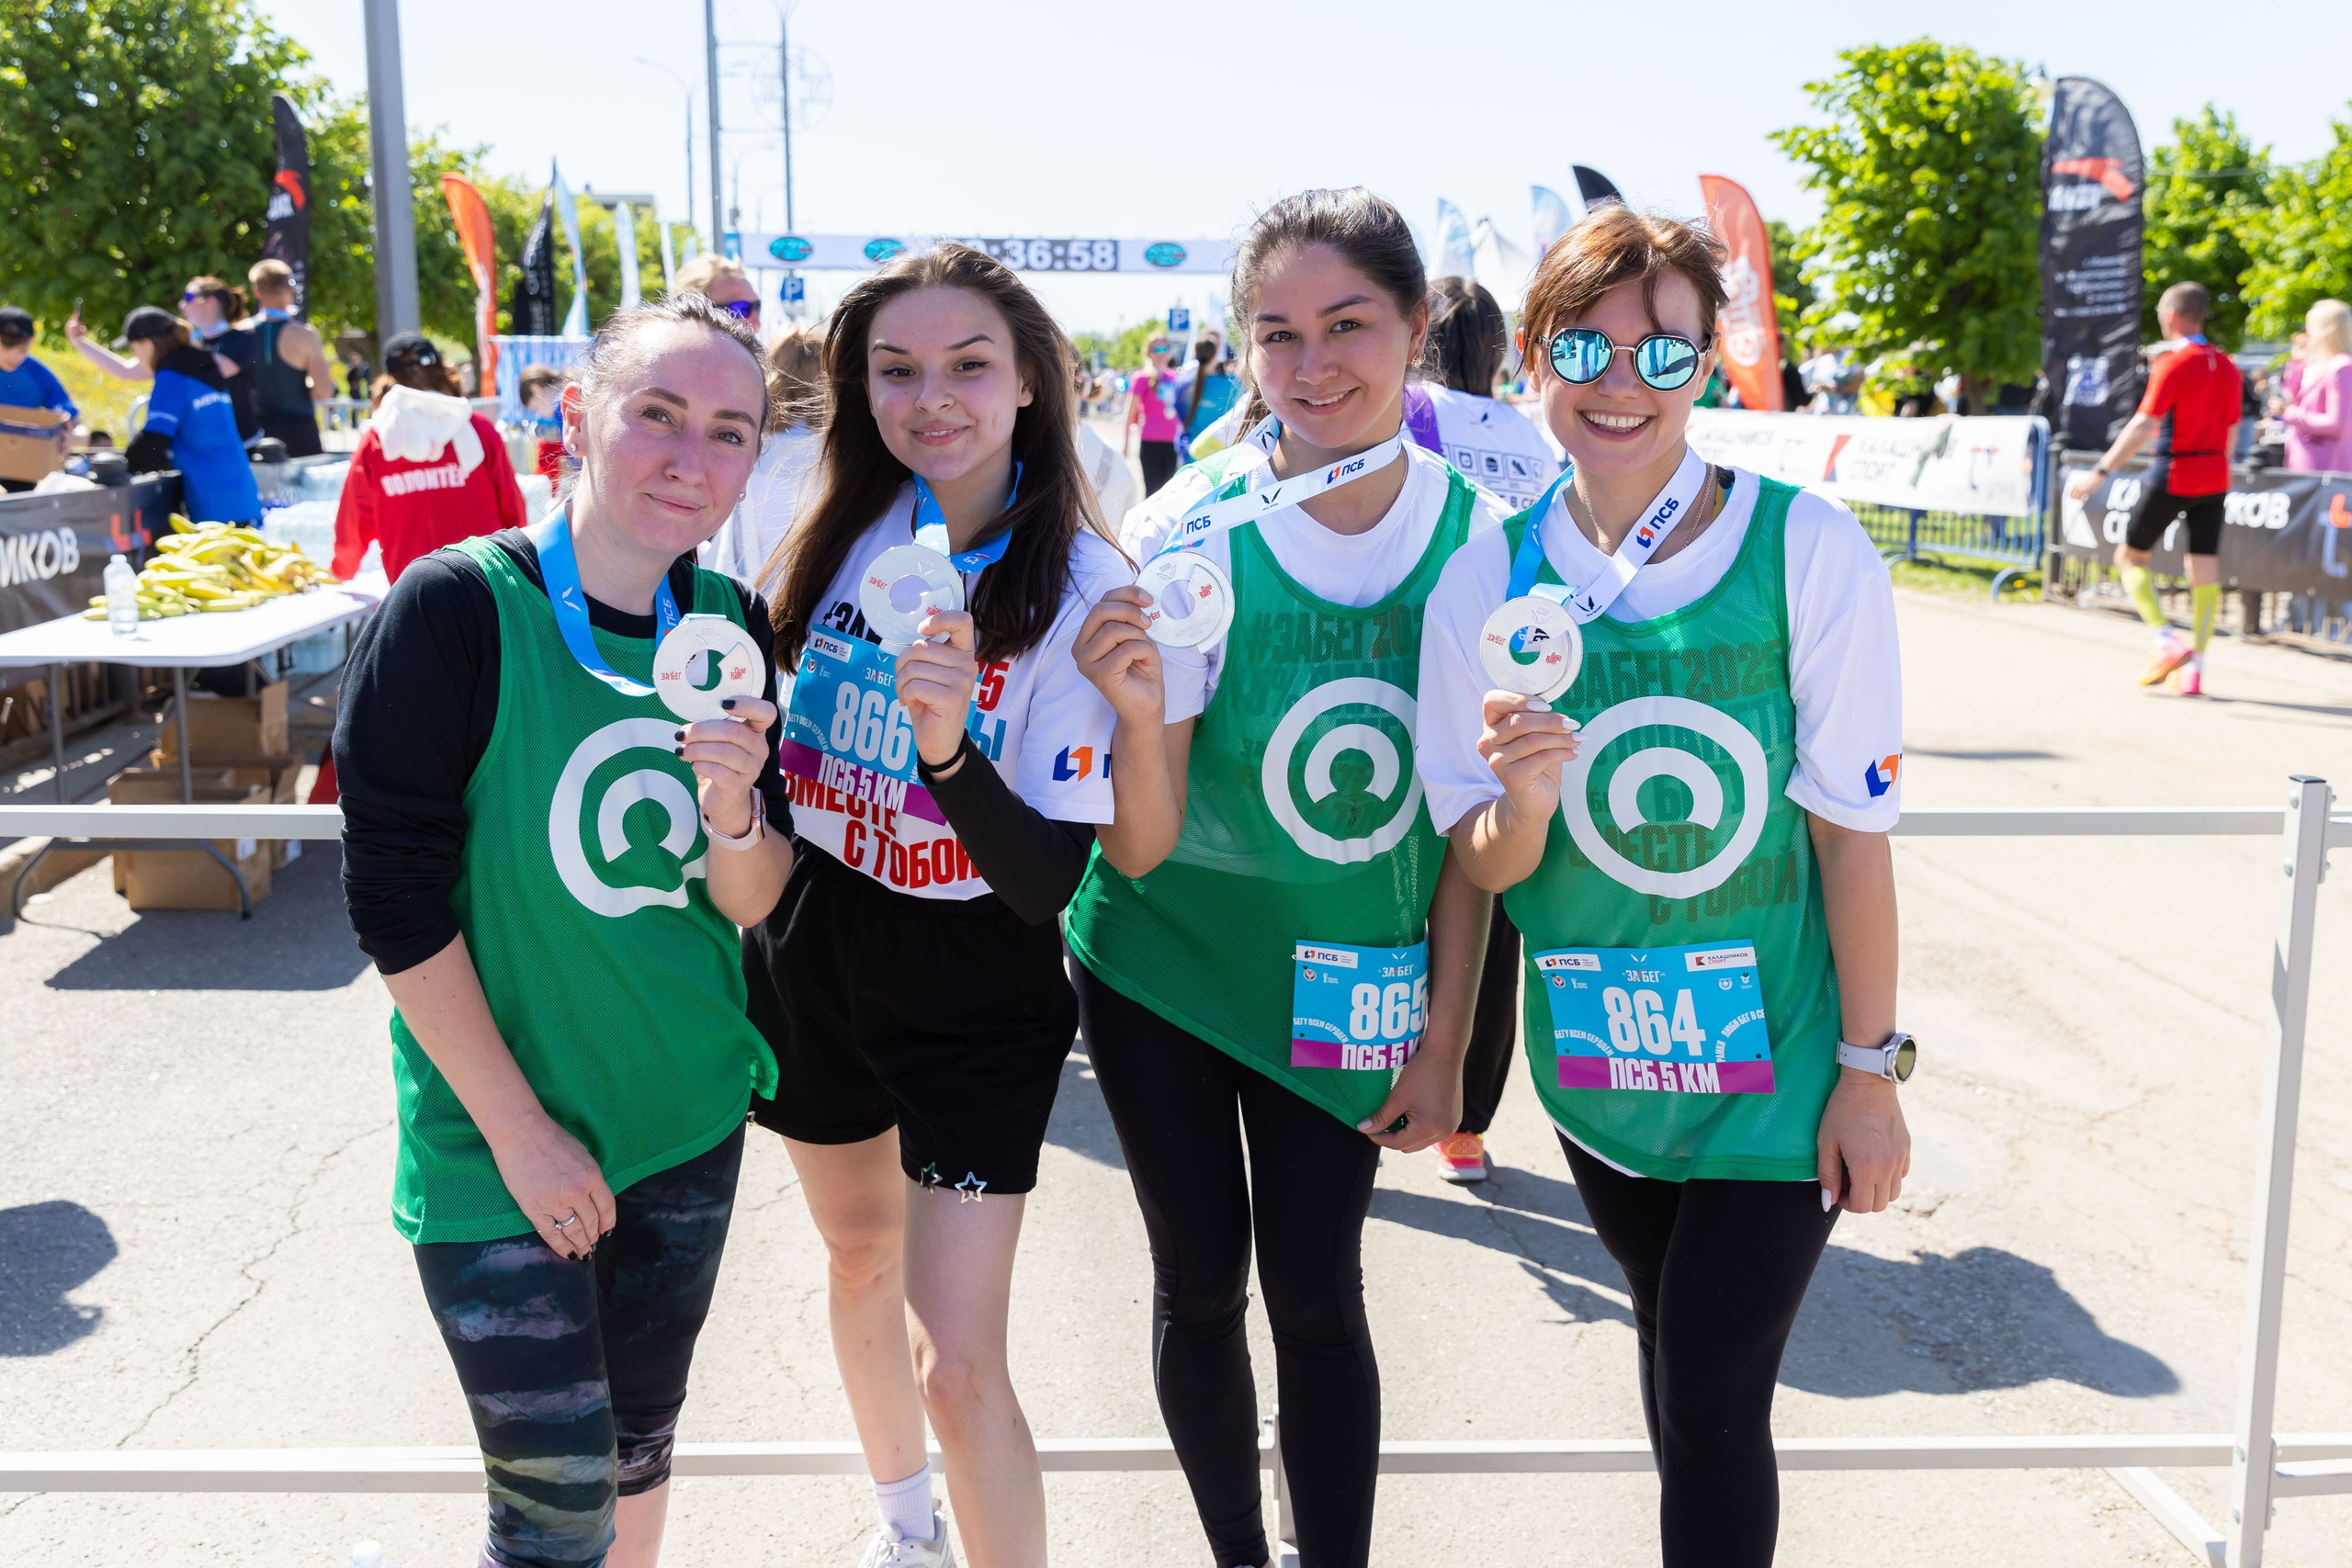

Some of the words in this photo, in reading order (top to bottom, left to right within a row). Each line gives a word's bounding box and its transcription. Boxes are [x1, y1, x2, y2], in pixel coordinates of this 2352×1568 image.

[1340, 457, 1365, 477] ПСБ
[1186, 515, 1212, 535] ПСБ
[1649, 497, 1679, 530] ПСБ
[662, 597, 678, 626] ПСБ
[823, 641, 839, 654] ПСБ
[830, 681, 912, 772] 866
[817, 751, 858, 796] ПСБ
[857, 766, 874, 802] 5
[872, 772, 909, 814] КМ
[843, 819, 867, 869] С
[1317, 952, 1339, 962] ПСБ
[1559, 958, 1581, 966] ПСБ
[1707, 952, 1748, 961] КАЛАШНИКОВ
[1349, 970, 1429, 1041] 865
[1293, 1017, 1308, 1026] БЕГУ
[1307, 1018, 1326, 1029] ВСЕМ
[1325, 1021, 1350, 1043] СЕРДЦЕМ
[1602, 986, 1707, 1056] 864
[1554, 1029, 1569, 1040] БЕГУ
[1569, 1029, 1587, 1040] ВСЕМ
[1587, 1032, 1614, 1057] СЕРДЦЕМ
[1714, 1040, 1726, 1063] РАМКИ
[1736, 1012, 1751, 1026] БЕГ
[1749, 1010, 1758, 1021] В
[1340, 1043, 1387, 1071] ПСБ
[1390, 1042, 1405, 1069] 5
[1609, 1057, 1659, 1091] ПСБ
[1658, 1061, 1679, 1093] 5
[1679, 1062, 1722, 1094] КМ
